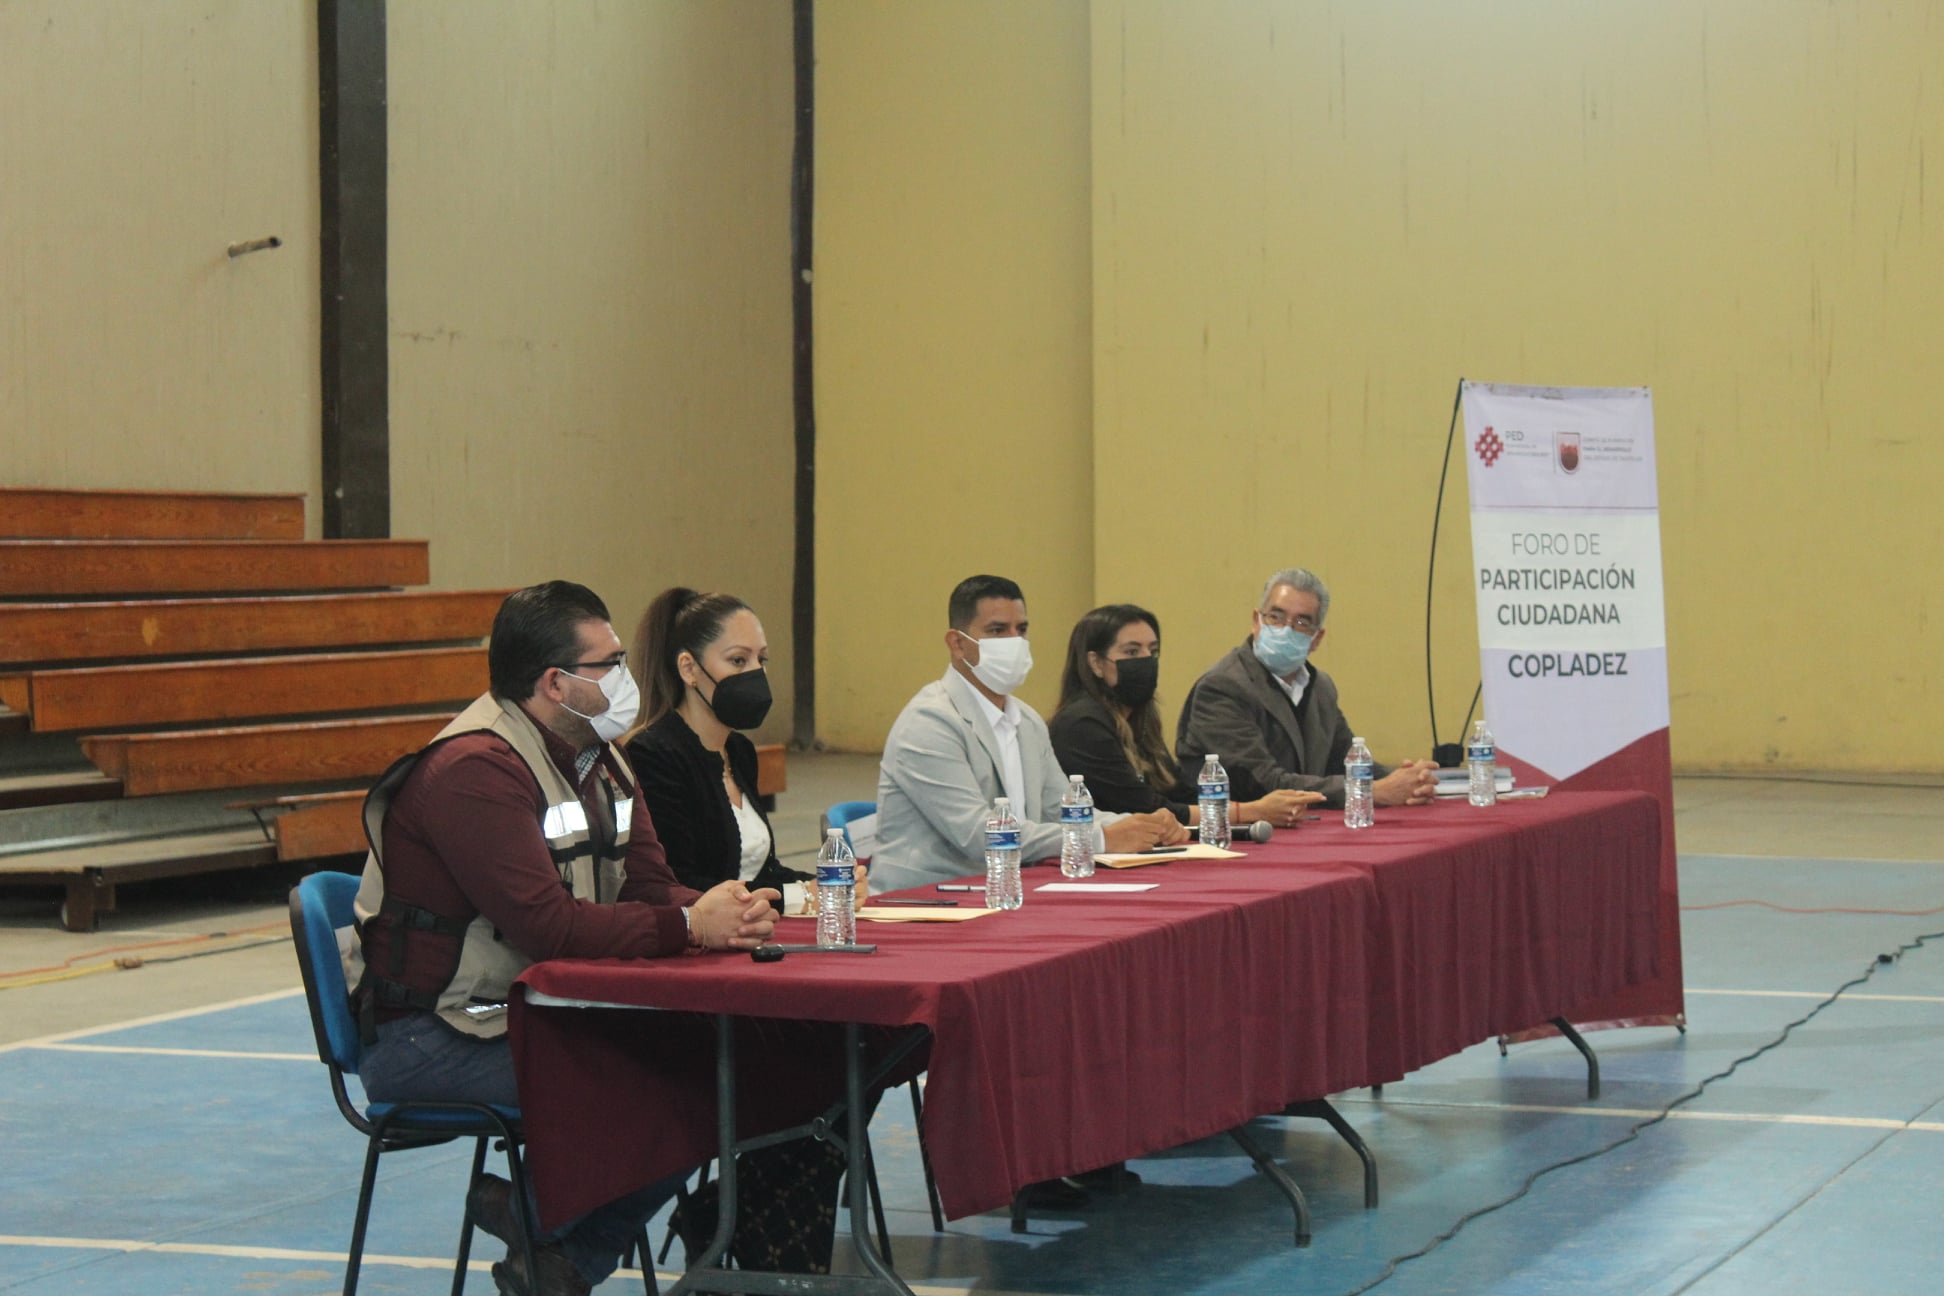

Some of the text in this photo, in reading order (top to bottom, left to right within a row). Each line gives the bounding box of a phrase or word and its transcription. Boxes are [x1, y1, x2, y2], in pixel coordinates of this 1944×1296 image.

[1505, 430, 1524, 441] PED
[1512, 533, 1601, 555] FORO DE
[1480, 562, 1636, 590] PARTICIPACIÓN
[1497, 603, 1621, 625] CIUDADANA
[1508, 652, 1628, 678] COPLADEZ
